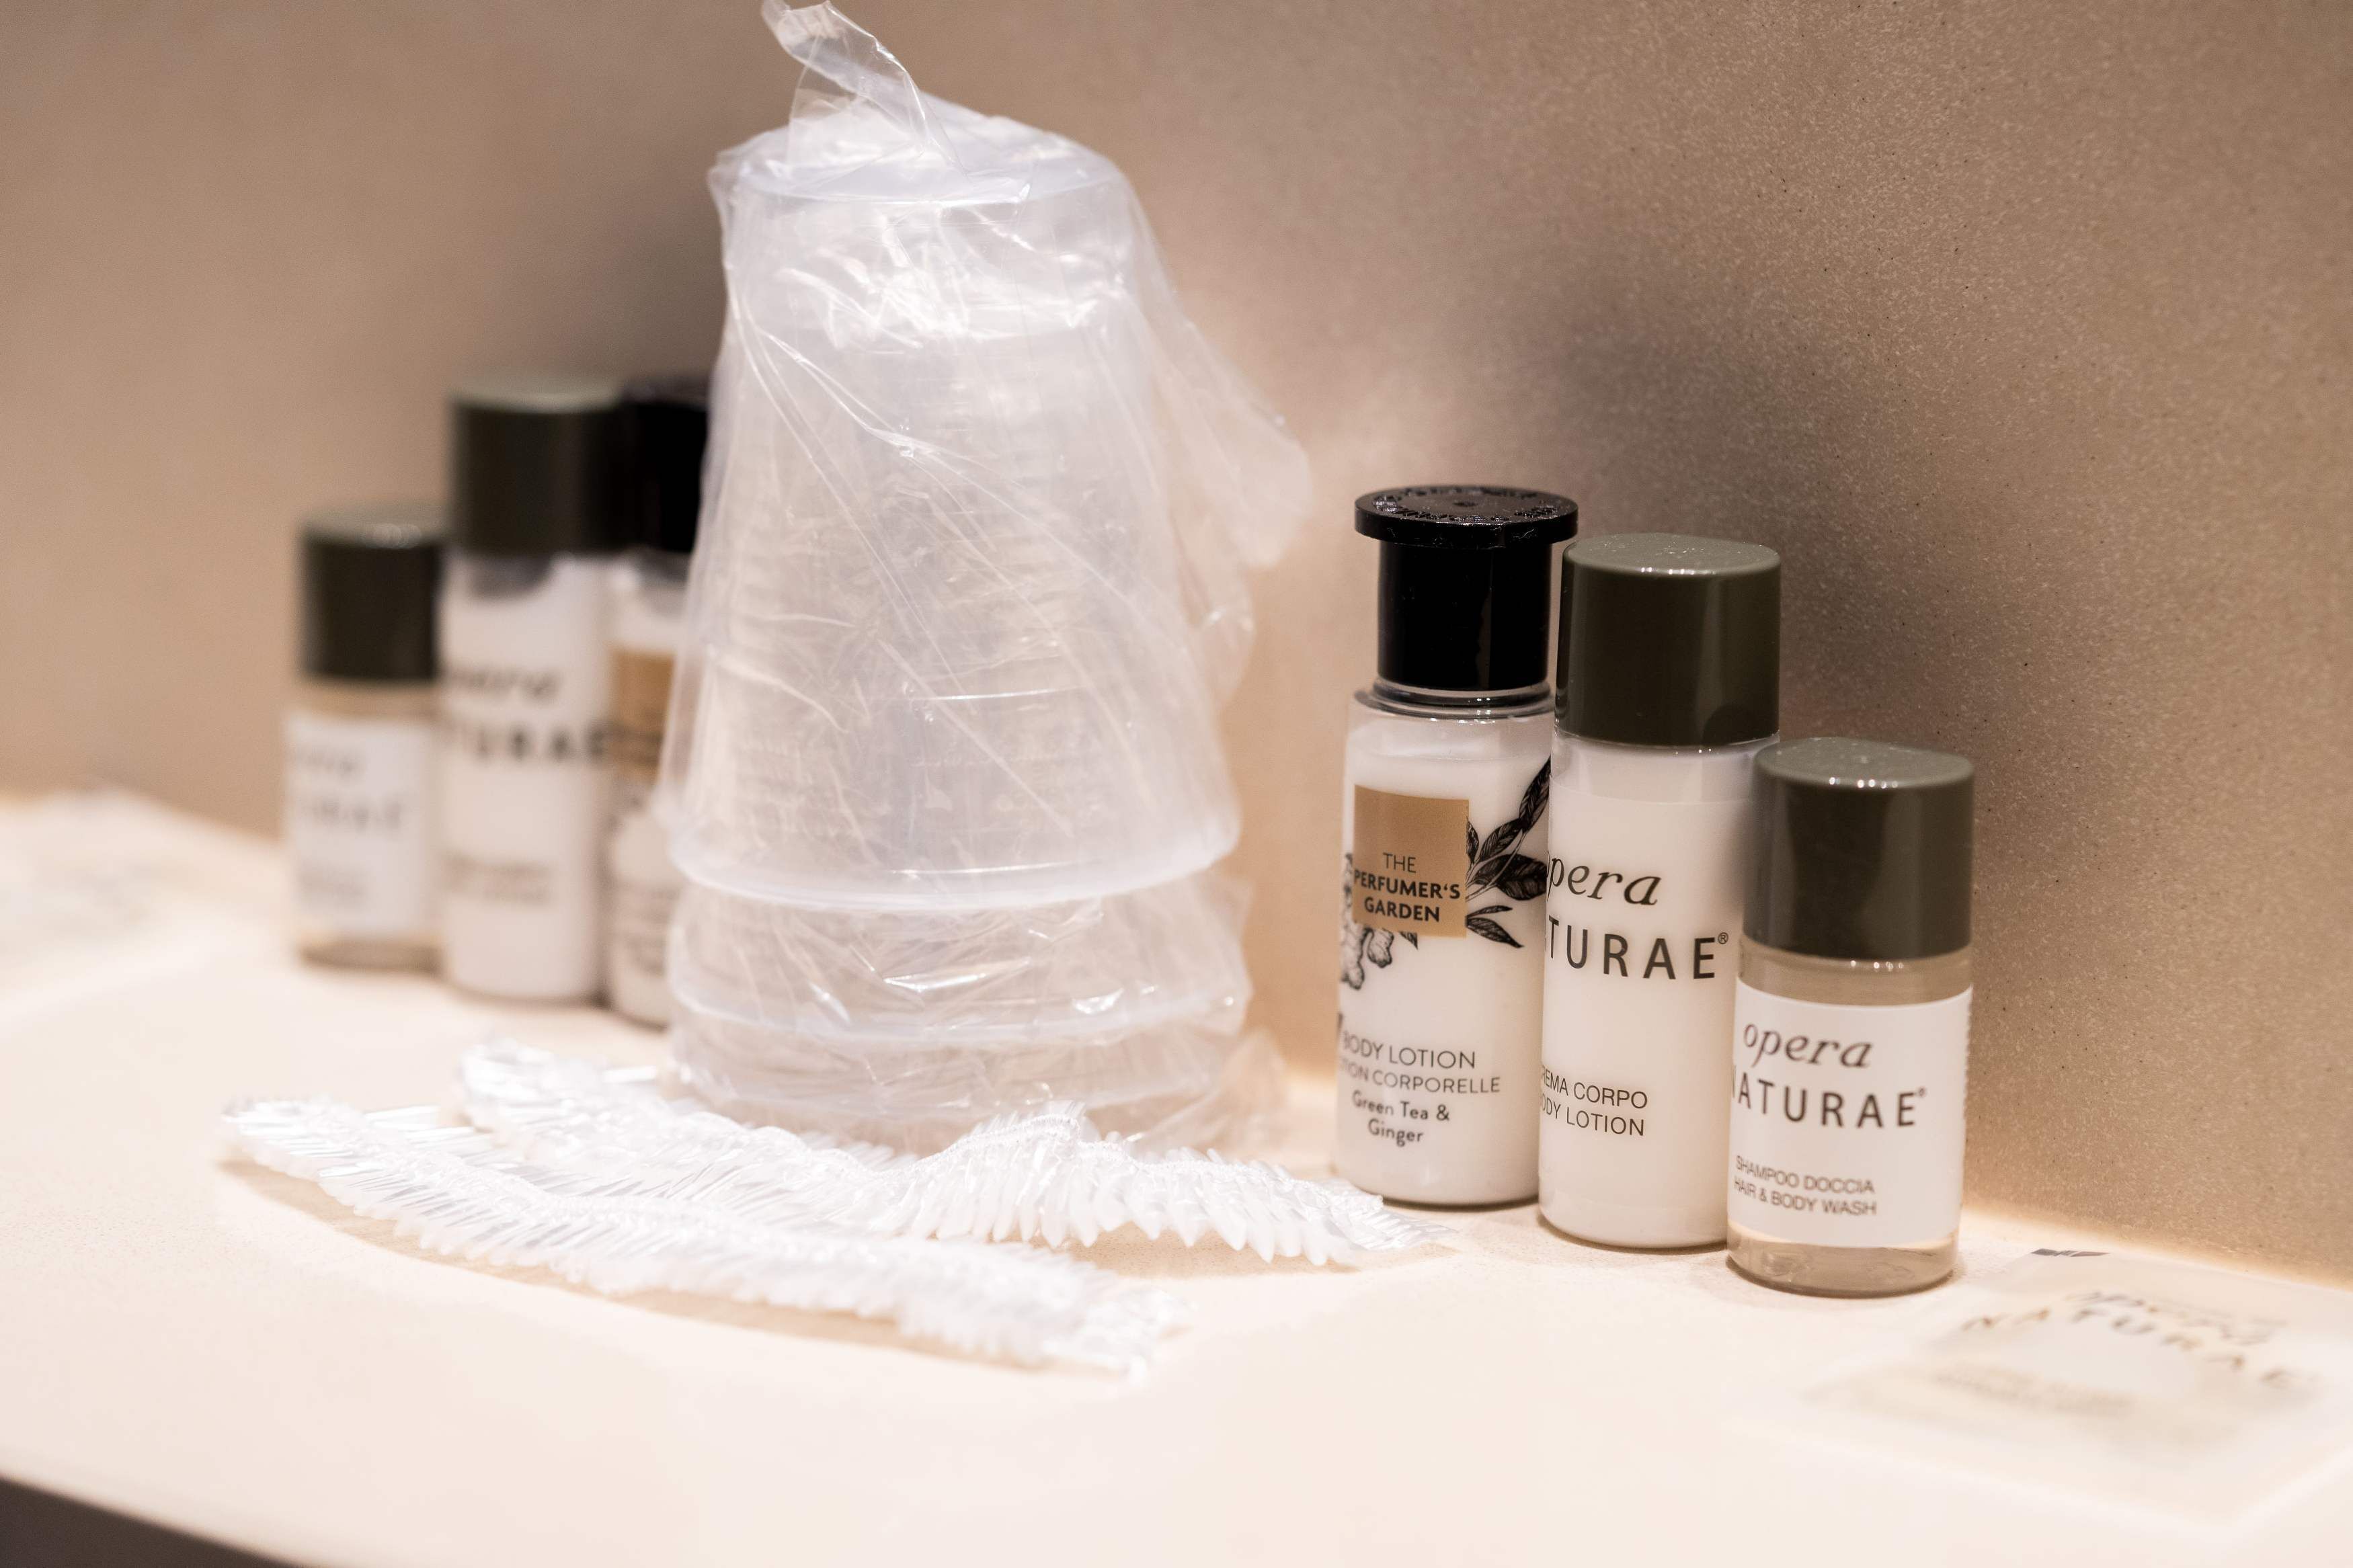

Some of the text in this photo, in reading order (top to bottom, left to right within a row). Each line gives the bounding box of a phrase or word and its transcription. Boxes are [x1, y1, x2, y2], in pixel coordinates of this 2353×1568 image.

[1382, 852, 1417, 874] THE
[1363, 896, 1440, 923] GARDEN
[1545, 915, 1728, 980] TURAE®
[1389, 1045, 1476, 1069] LOTION
[1743, 1024, 1873, 1068] opera
[1372, 1070, 1501, 1094] CORPORELLE
[1542, 1064, 1647, 1109] REMA CORPO
[1732, 1065, 1927, 1128] ATURAE®
[1351, 1089, 1450, 1121] Green Tea &
[1541, 1093, 1644, 1136] ODY LOTION
[1367, 1118, 1424, 1147] Ginger
[1735, 1155, 1876, 1194] SHAMPOO DOCCIA
[1733, 1176, 1878, 1216] HAIR & BODY WASH
